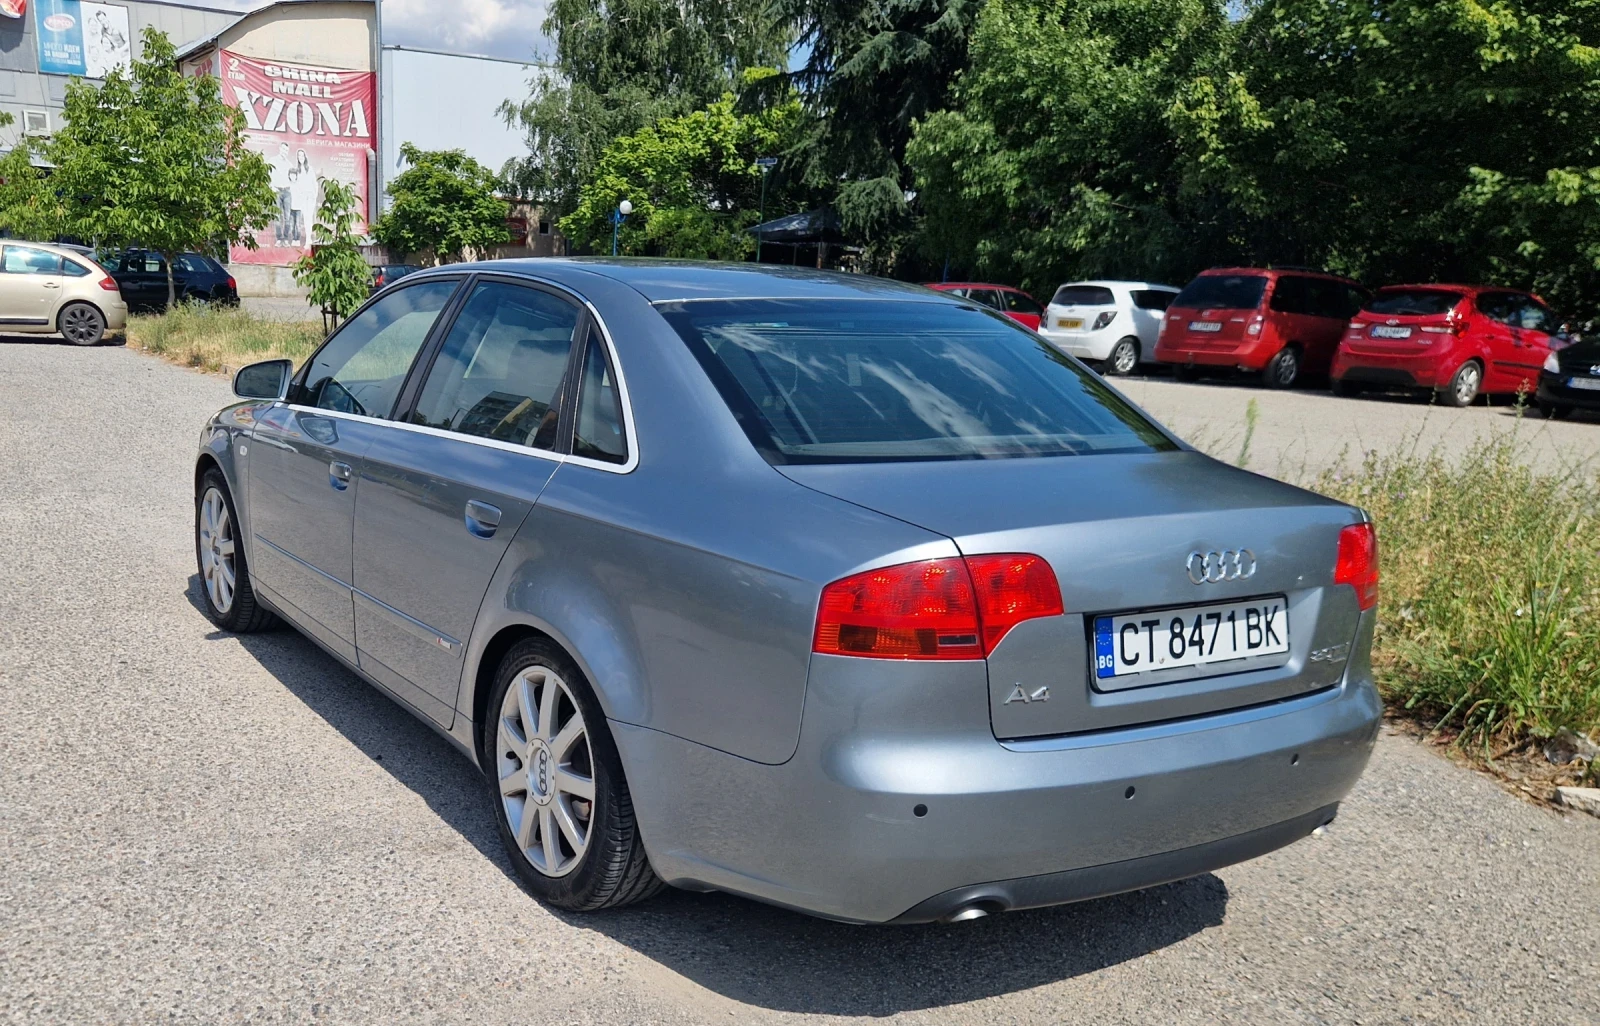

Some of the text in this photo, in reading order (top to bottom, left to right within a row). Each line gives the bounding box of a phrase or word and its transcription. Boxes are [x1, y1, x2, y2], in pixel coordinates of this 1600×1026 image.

[272, 80, 334, 99] MALL
[233, 86, 370, 138] XZONA
[306, 138, 371, 149] ВЕРИГА МАГАЗИНИ
[1099, 605, 1281, 670] BG CT 8471 BK
[1004, 682, 1050, 704] A4
